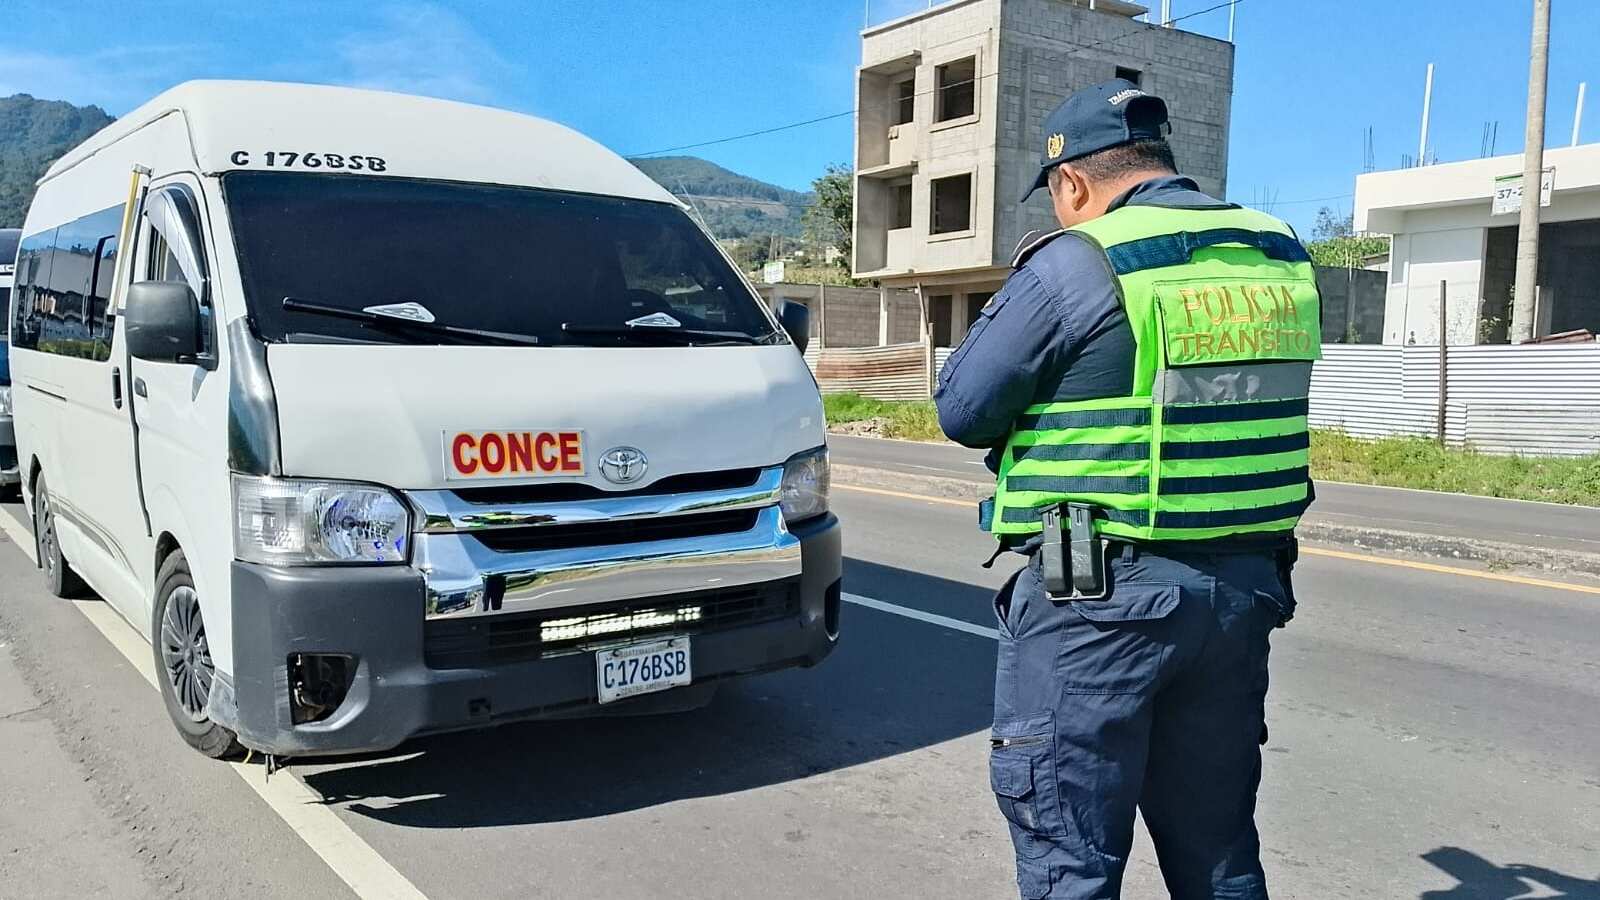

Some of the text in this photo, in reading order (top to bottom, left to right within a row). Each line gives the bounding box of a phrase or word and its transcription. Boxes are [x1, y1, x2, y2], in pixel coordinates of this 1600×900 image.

[230, 151, 387, 172] C 176BSB
[1179, 285, 1297, 327] POLICIA
[1175, 328, 1311, 356] TRANSITO
[452, 432, 581, 474] CONCE
